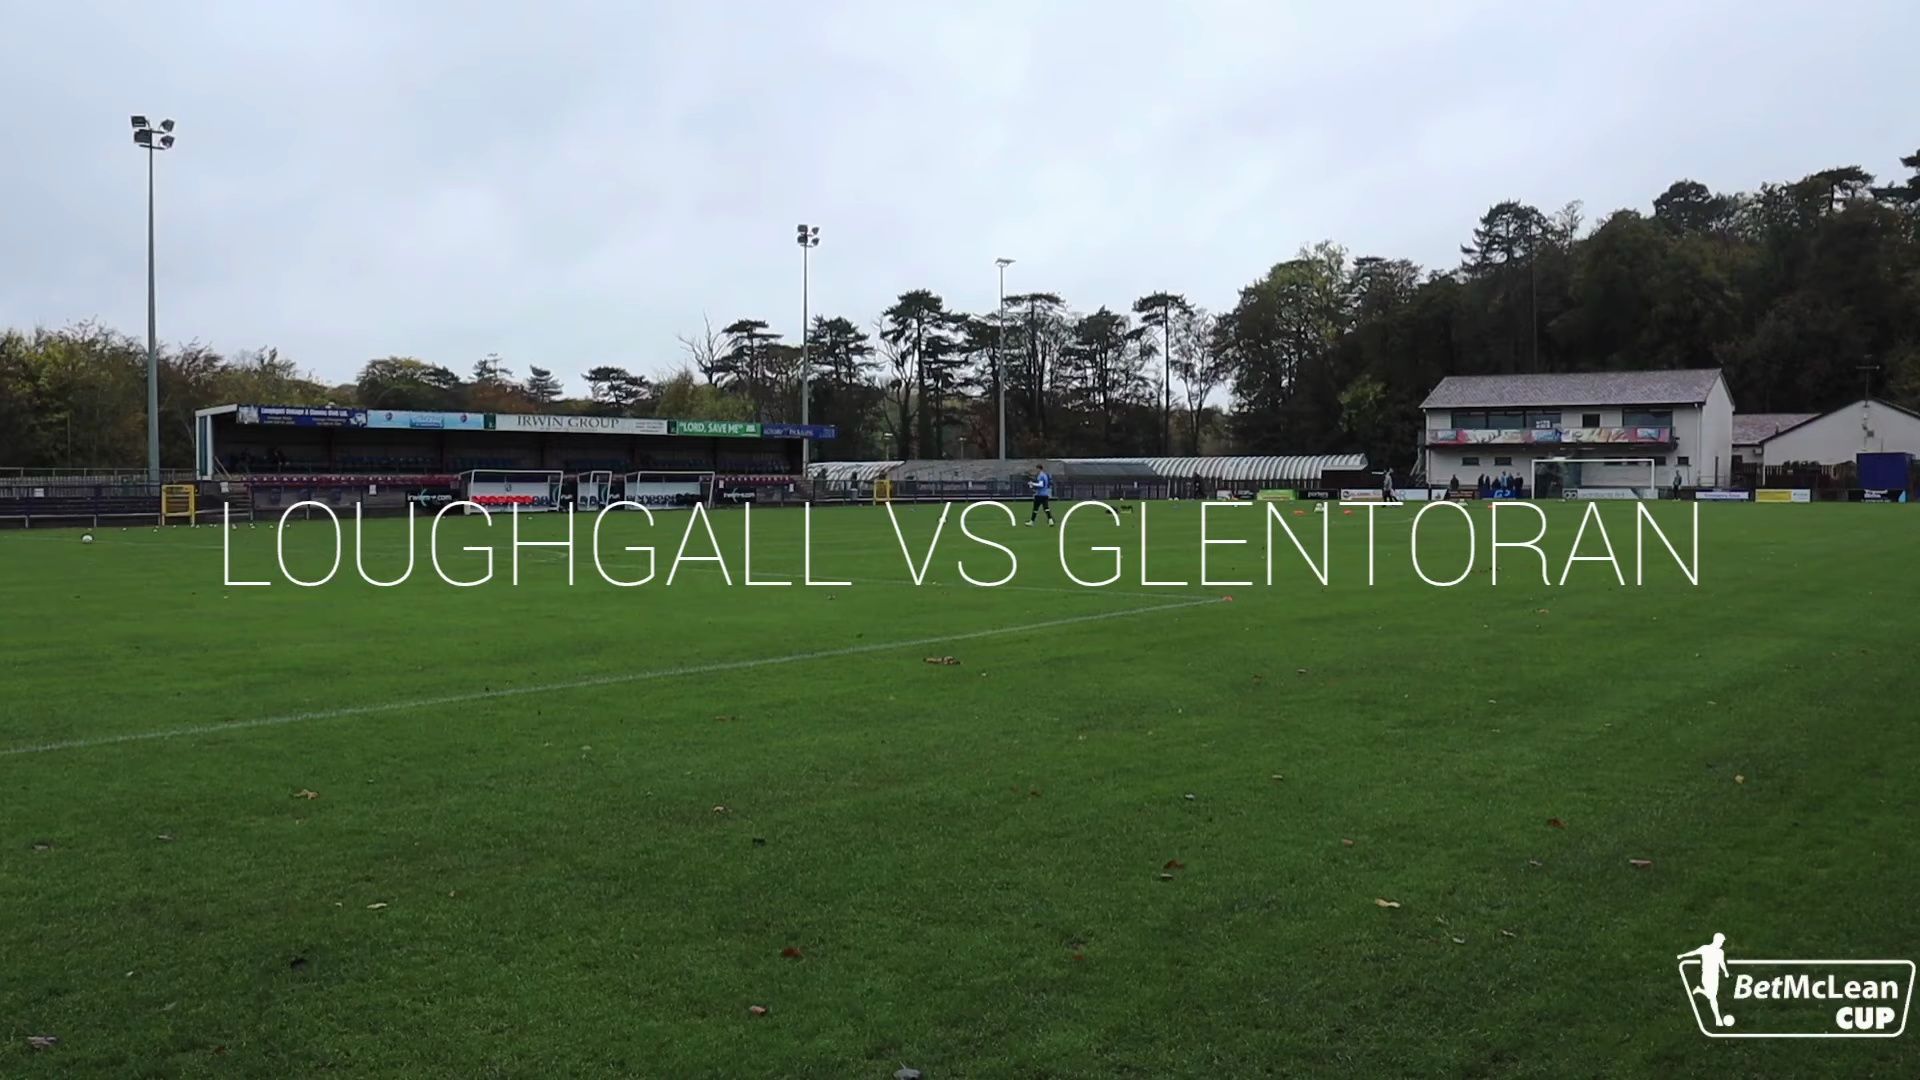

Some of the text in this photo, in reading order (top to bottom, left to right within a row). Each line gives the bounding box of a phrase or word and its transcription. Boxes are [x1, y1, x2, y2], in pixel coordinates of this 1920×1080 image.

[517, 415, 620, 428] IRWIN GROUP
[708, 423, 727, 433] SAVE
